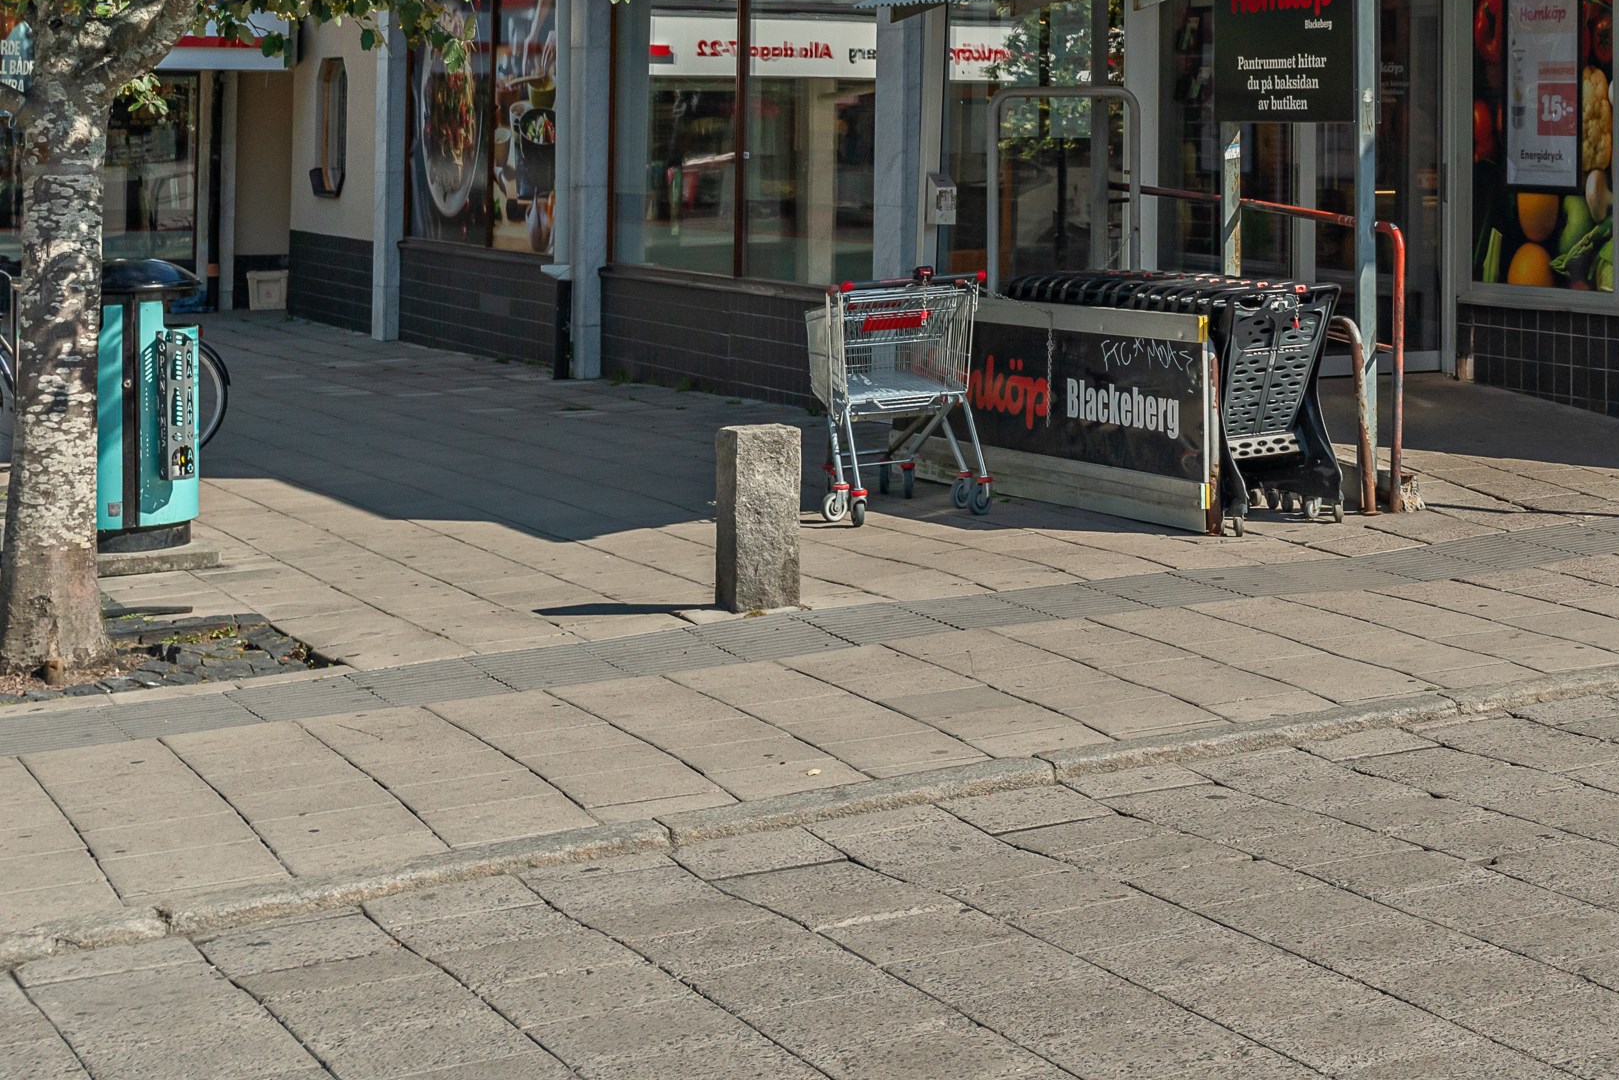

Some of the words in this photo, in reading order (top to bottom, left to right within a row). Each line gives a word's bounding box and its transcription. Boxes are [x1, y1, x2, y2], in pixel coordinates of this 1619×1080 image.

[1519, 4, 1567, 23] Hemköp
[1304, 19, 1333, 31] Blackeberg
[1237, 54, 1296, 71] Pantrummet
[1297, 53, 1327, 69] hittar
[1247, 75, 1260, 90] du
[1260, 74, 1273, 94] på
[1274, 74, 1320, 90] baksidan
[1258, 100, 1270, 111] av
[1271, 95, 1308, 110] butiken
[1520, 149, 1564, 163] Energidryck
[1066, 377, 1180, 440] Blackeberg
